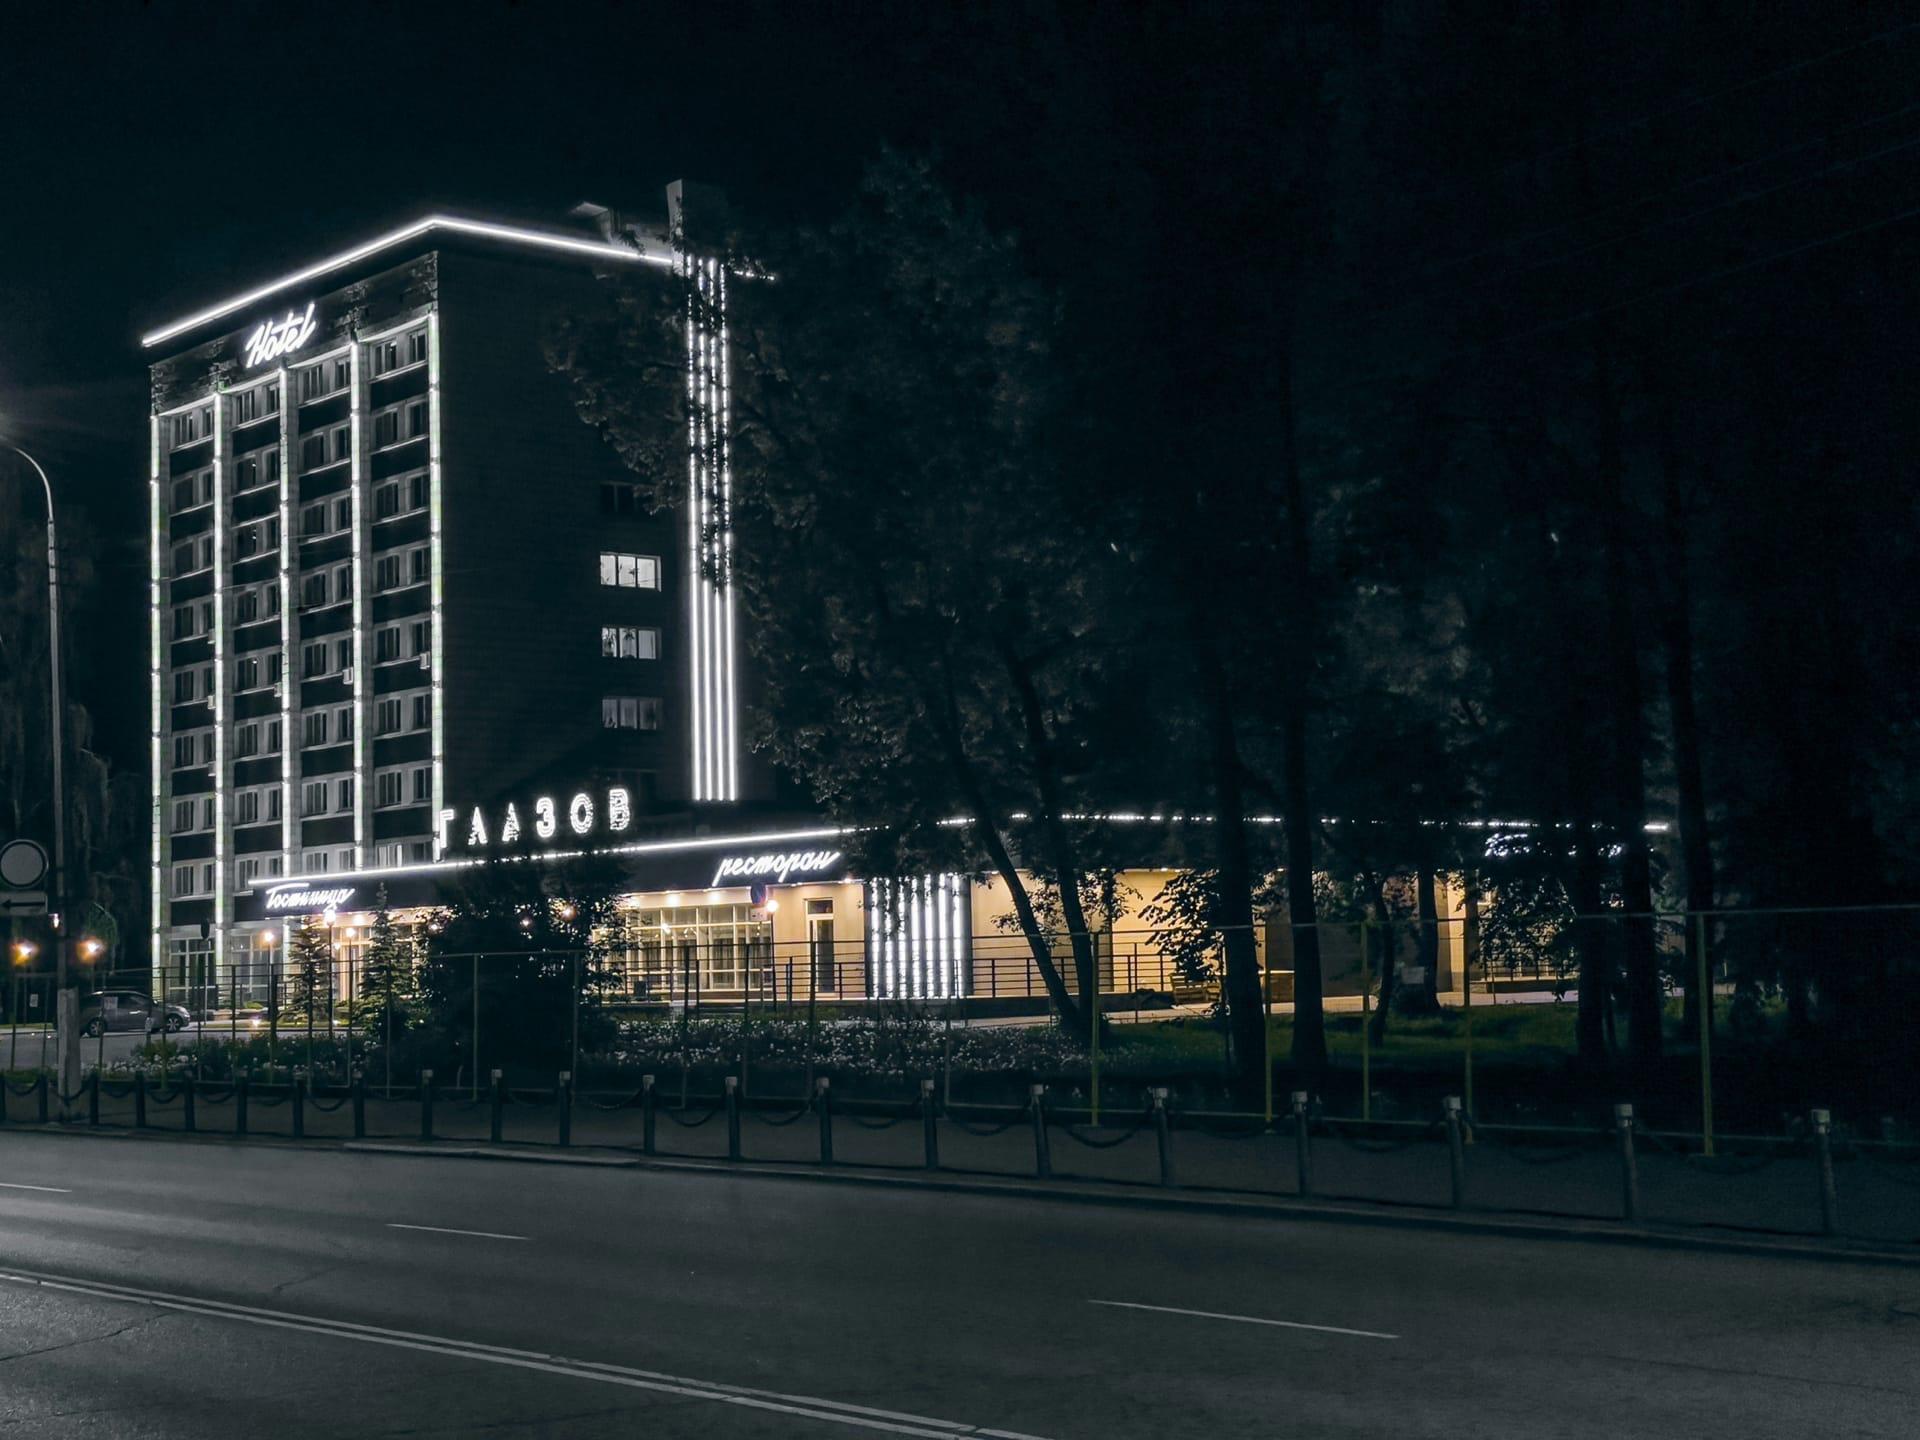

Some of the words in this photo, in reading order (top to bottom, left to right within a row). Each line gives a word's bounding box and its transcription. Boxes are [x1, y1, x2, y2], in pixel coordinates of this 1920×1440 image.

[245, 302, 317, 369] Hotel
[439, 788, 630, 849] ГЛАЗОВ
[711, 851, 841, 887] ресторан
[265, 882, 356, 912] Гостиница
